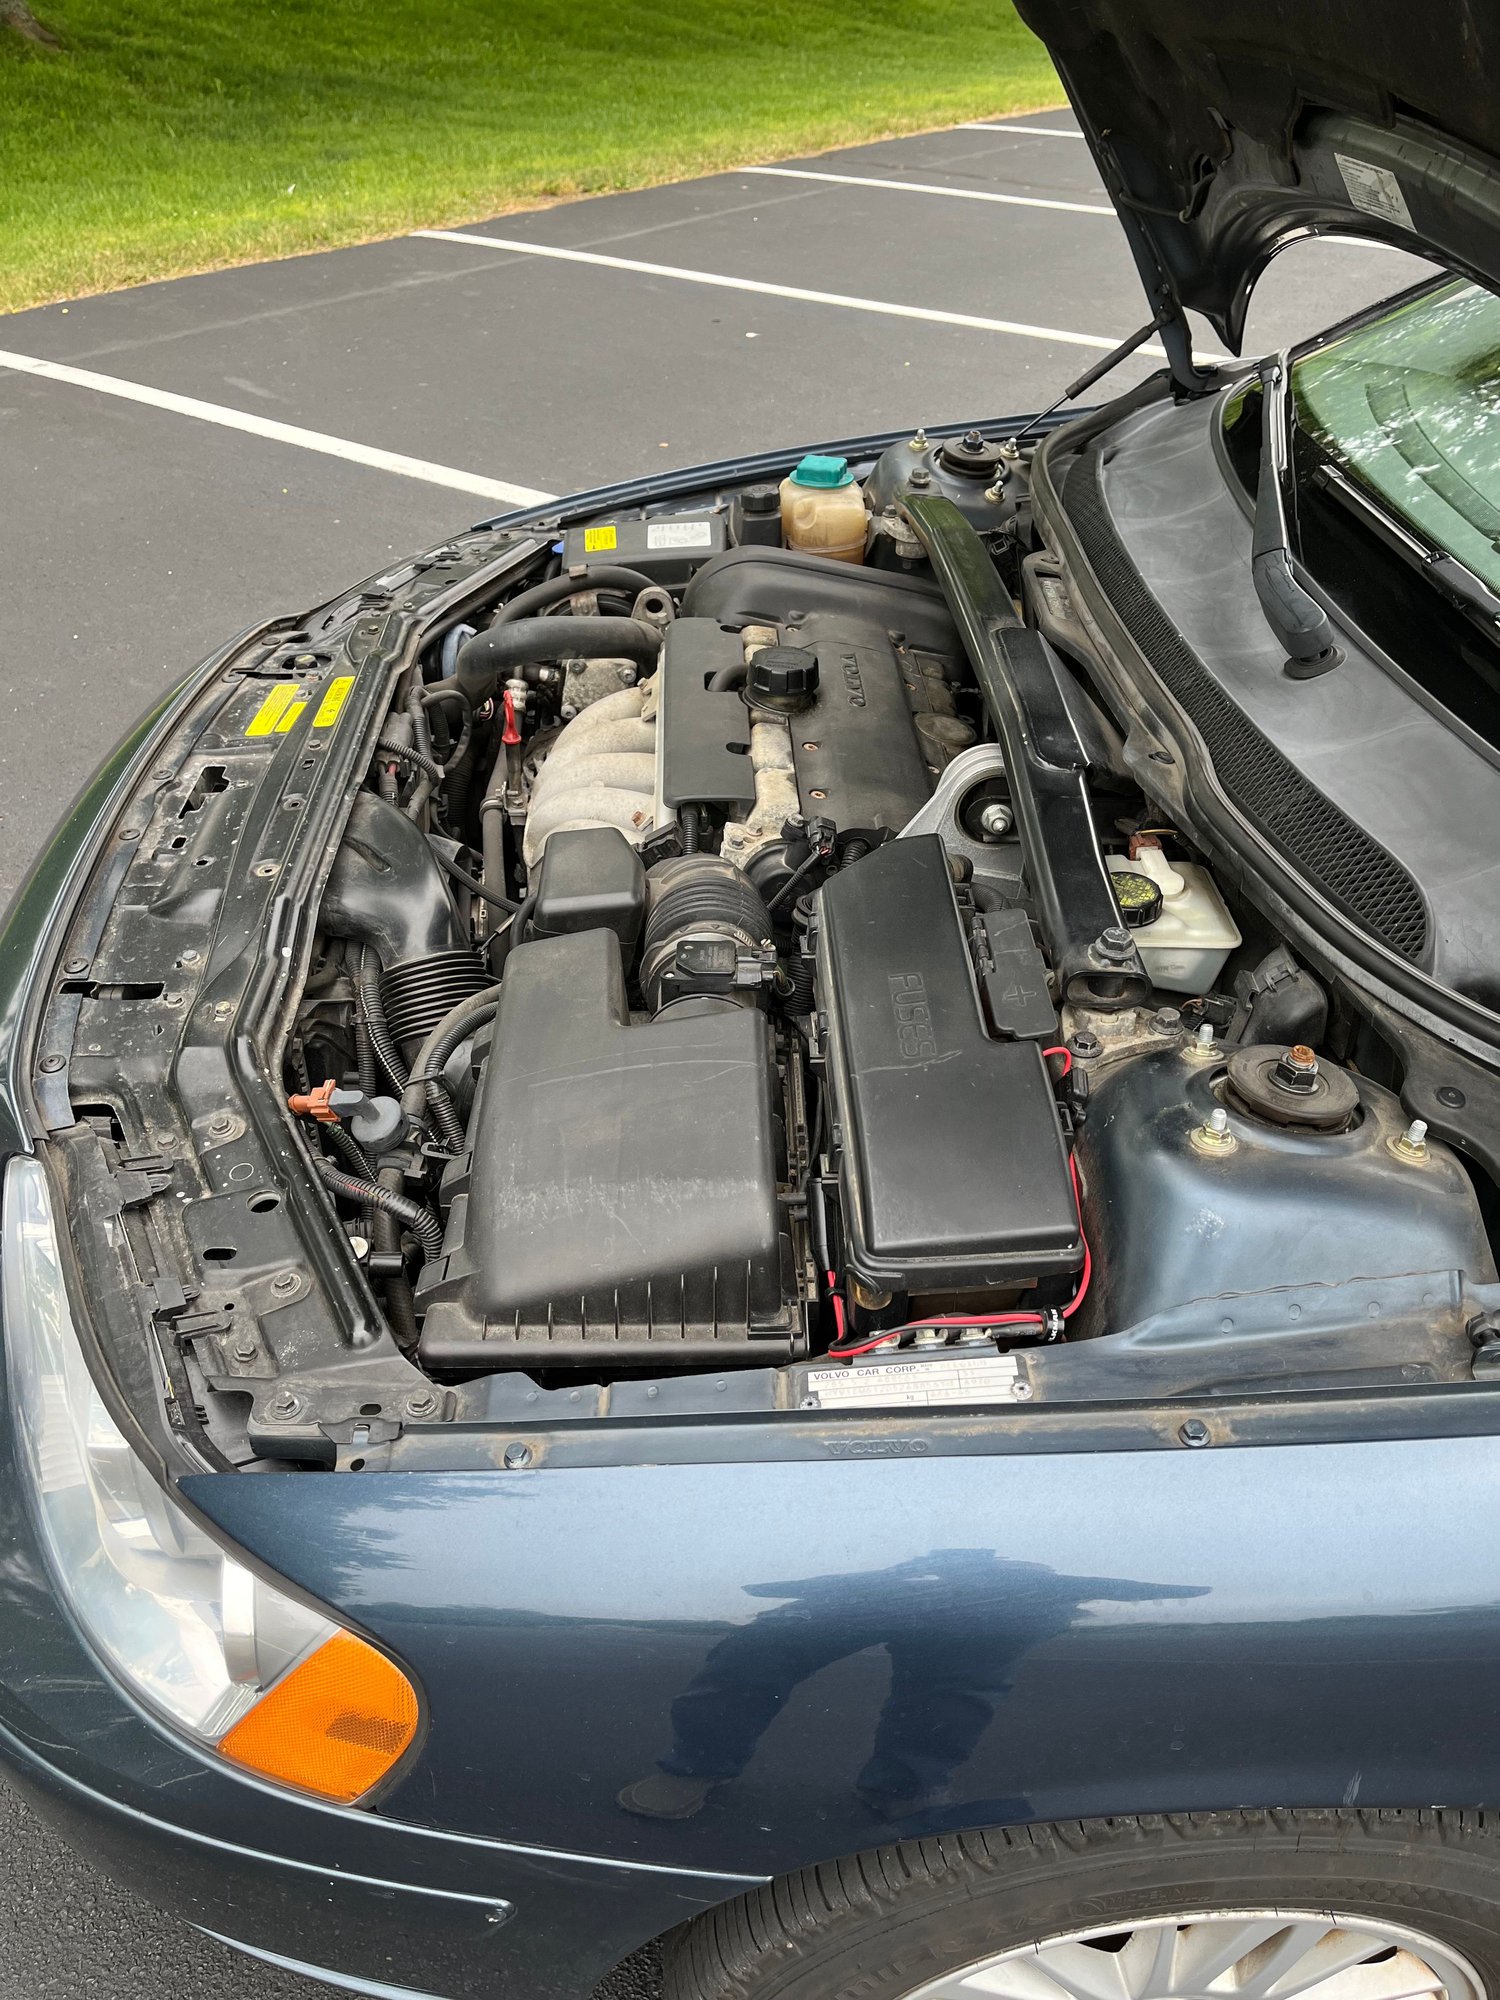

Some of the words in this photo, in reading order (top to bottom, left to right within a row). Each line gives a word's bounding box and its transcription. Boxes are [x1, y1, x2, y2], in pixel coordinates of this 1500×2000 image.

[840, 653, 867, 708] VOLVO
[888, 972, 937, 1058] FUSES
[814, 1371, 849, 1380] VOLVO
[857, 1368, 879, 1377] CAR
[886, 1365, 919, 1374] CORP.
[823, 1438, 929, 1455] VOLVO
